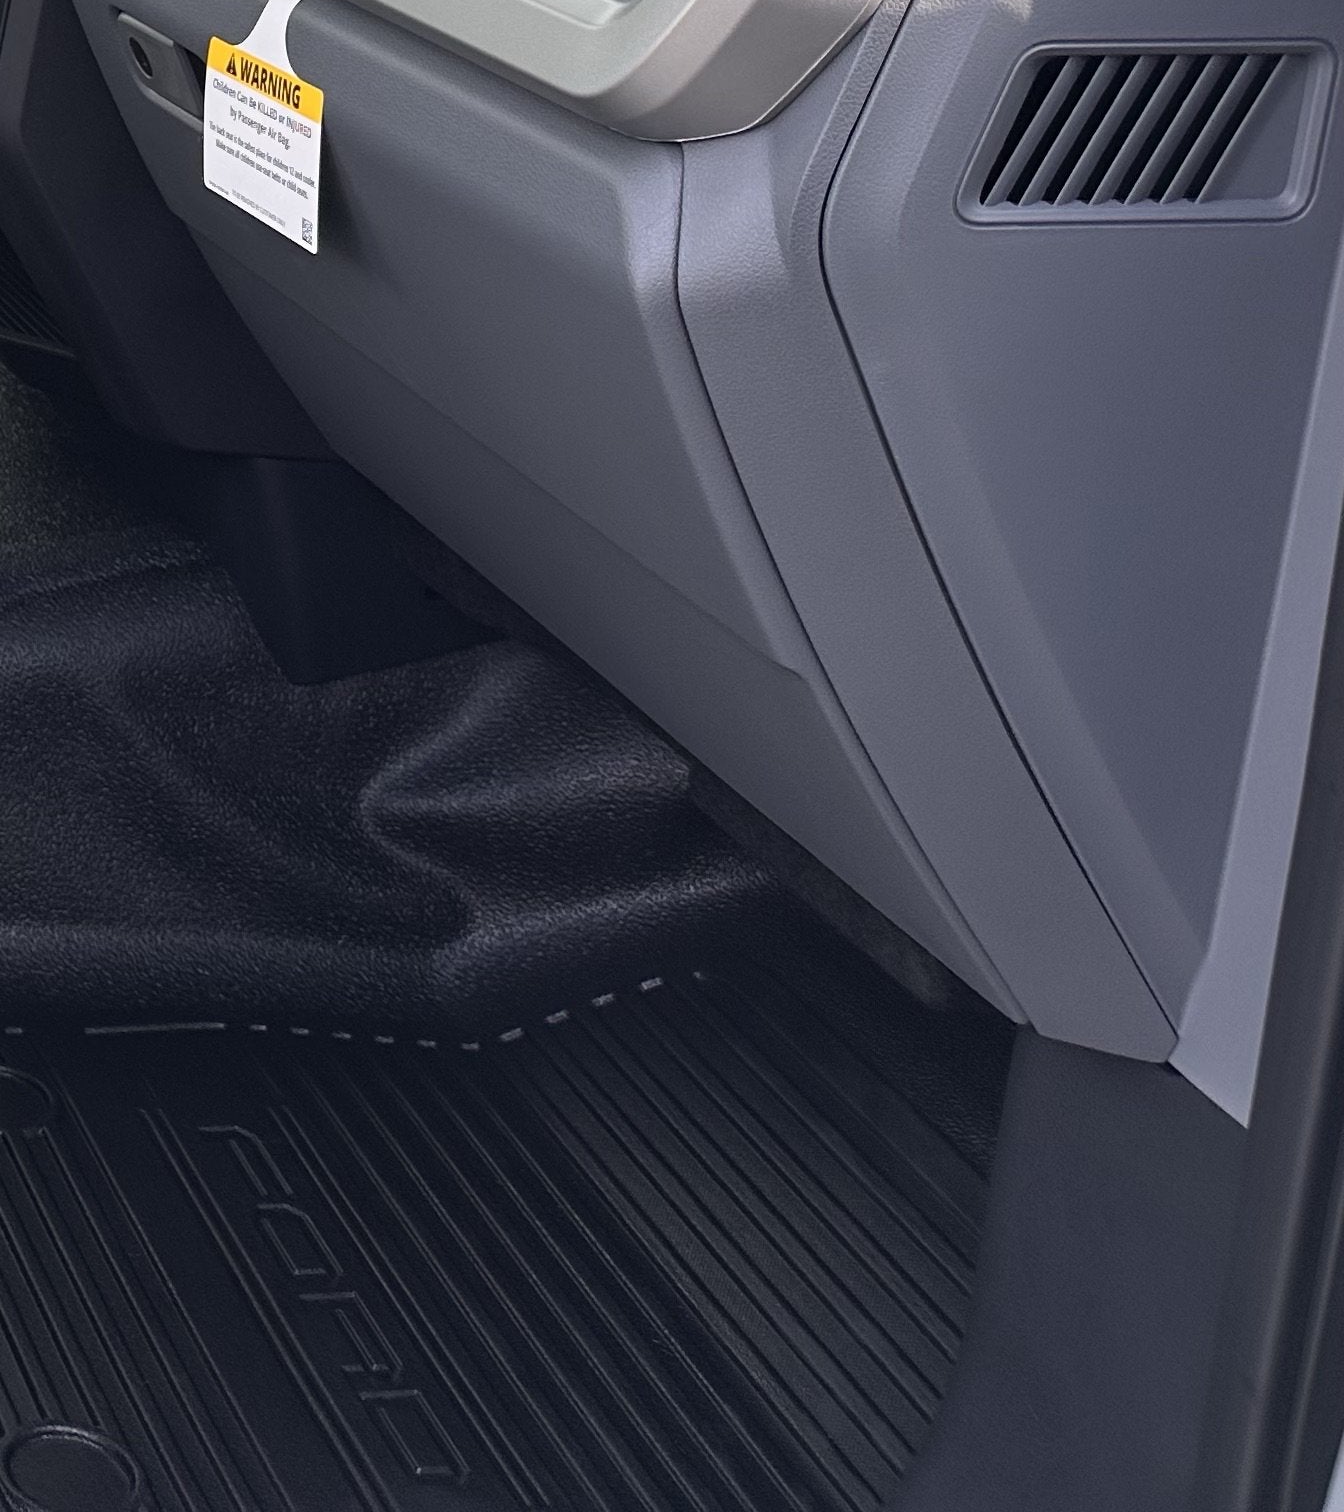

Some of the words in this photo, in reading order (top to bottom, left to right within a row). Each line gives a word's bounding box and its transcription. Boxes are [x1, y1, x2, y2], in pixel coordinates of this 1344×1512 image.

[213, 78, 236, 98] Children
[237, 90, 248, 105] Can
[249, 96, 257, 109] Be
[257, 100, 278, 121] KILLED
[278, 114, 286, 125] or
[286, 116, 312, 139] INJURED
[240, 56, 301, 109] WARNING
[230, 105, 237, 121] by
[237, 110, 268, 136] Passenger
[268, 126, 278, 140] Air
